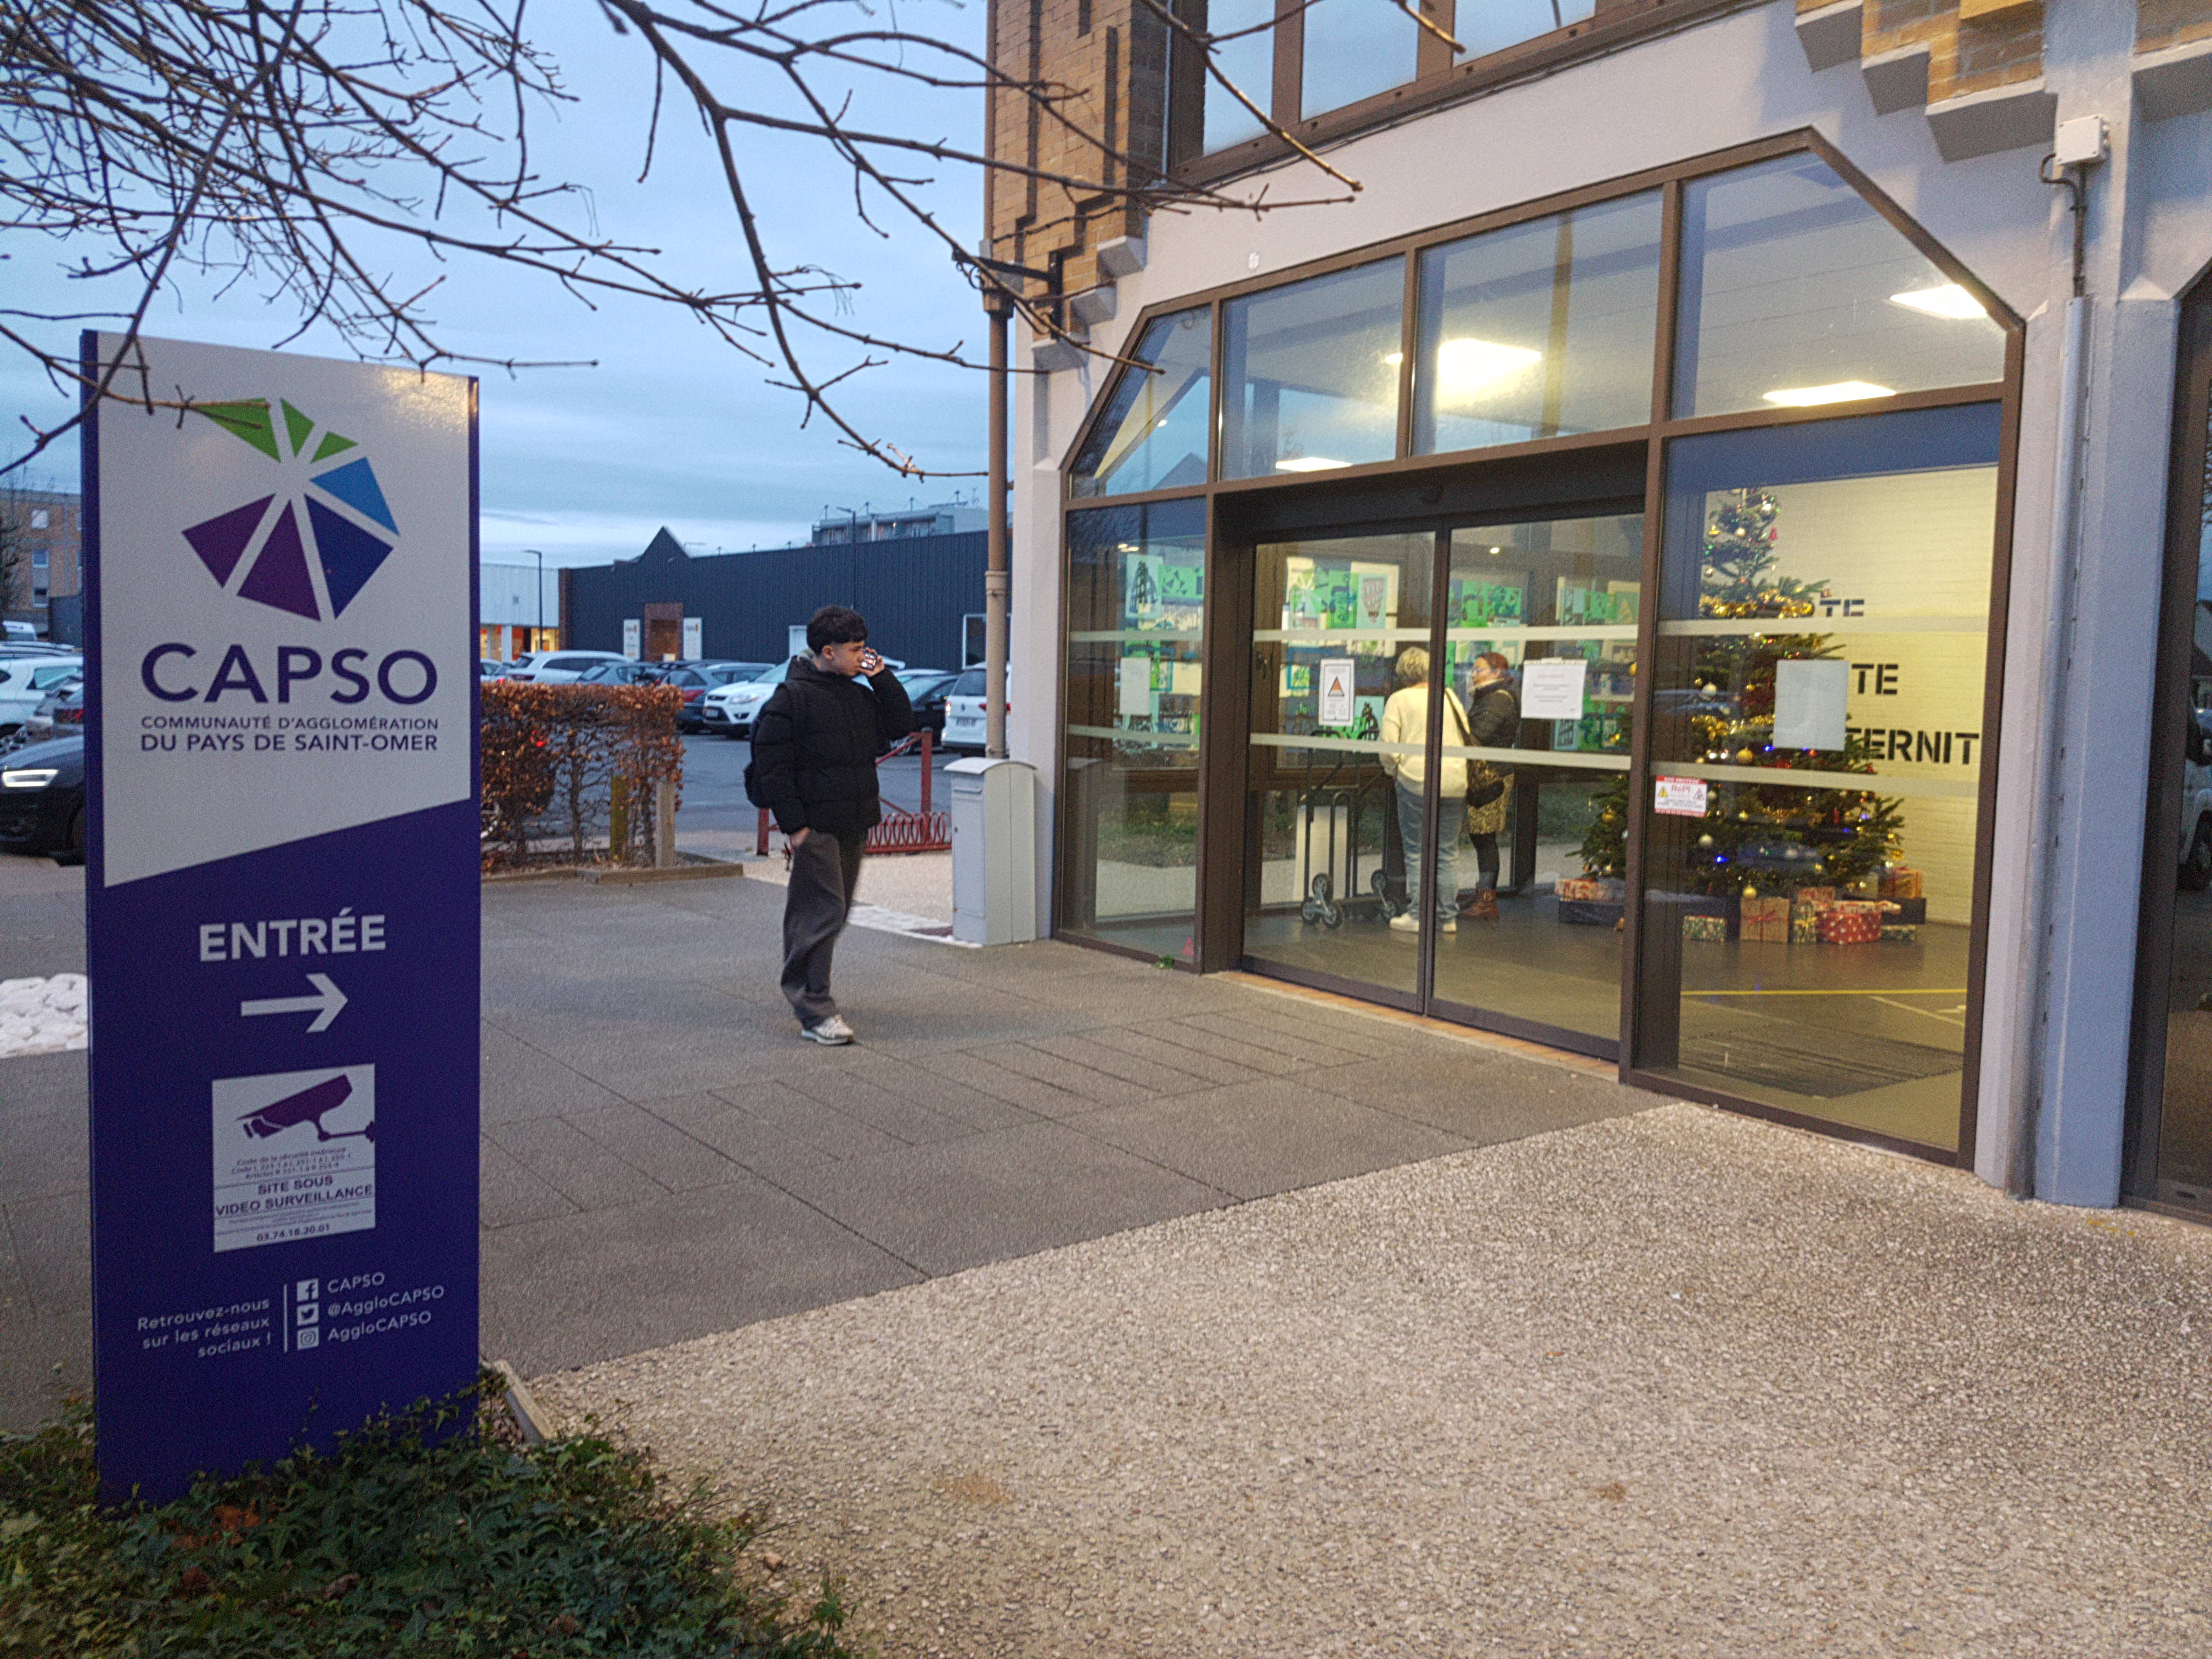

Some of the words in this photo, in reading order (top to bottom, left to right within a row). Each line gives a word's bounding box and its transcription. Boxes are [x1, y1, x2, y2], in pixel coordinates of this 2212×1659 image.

[141, 642, 438, 706] CAPSO
[141, 714, 271, 730] COMMUNAUTÉ
[279, 714, 438, 730] D'AGGLOMÉRATION
[141, 734, 176, 752] DU
[187, 733, 245, 752] PAYS
[255, 734, 286, 751] DE
[295, 734, 438, 752] SAINT-OMER
[199, 907, 386, 962] ENTRÉE
[216, 1200, 261, 1217] VIDEO
[265, 1184, 374, 1210] SURVEILLANCE
[257, 1180, 290, 1195] SITE
[294, 1175, 334, 1190] SOUS
[327, 1271, 386, 1295] CAPSO
[137, 1297, 270, 1332] Retrouvez-nous
[327, 1285, 445, 1319] @AggloCAPSO
[142, 1335, 169, 1350] sur
[174, 1329, 199, 1345] les
[205, 1316, 270, 1339] réseaux
[327, 1310, 432, 1344] AggloCAPSO
[198, 1335, 260, 1358] sociaux
